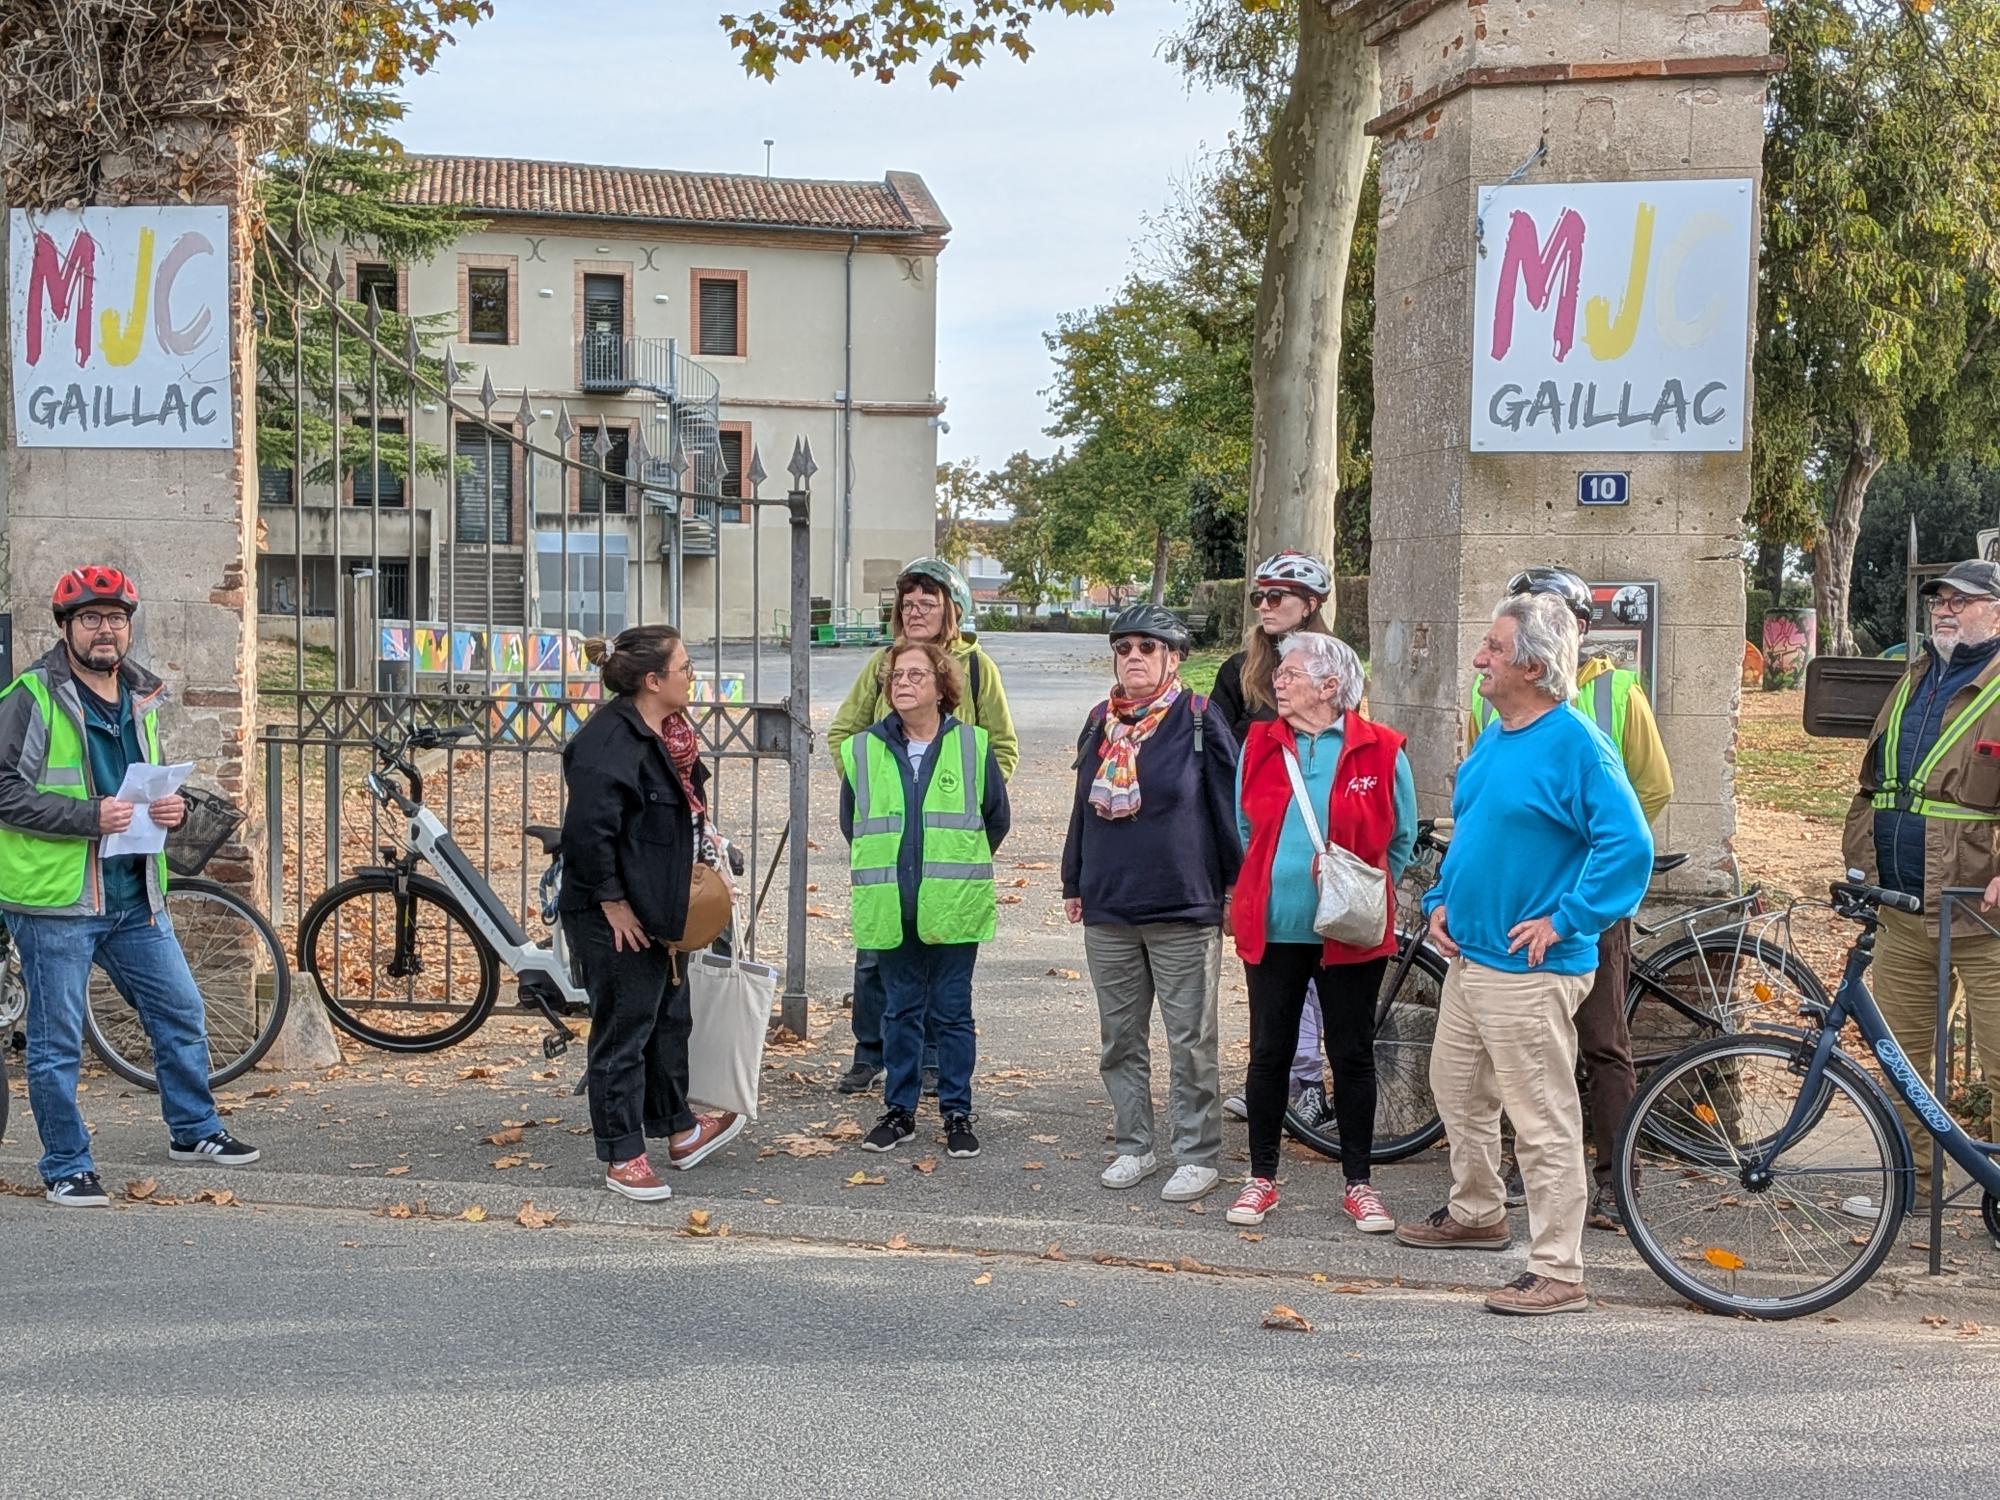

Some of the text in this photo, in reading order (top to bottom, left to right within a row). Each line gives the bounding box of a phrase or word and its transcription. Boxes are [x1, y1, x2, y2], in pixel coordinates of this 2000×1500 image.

[26, 226, 214, 368] MJC
[1490, 202, 1734, 363] MJC
[29, 383, 217, 432] GAILLAC
[1489, 378, 1728, 434] GAILLAC
[1589, 477, 1616, 500] 10
[437, 682, 471, 695] Fee
[1875, 1039, 1951, 1132] OXFORD
